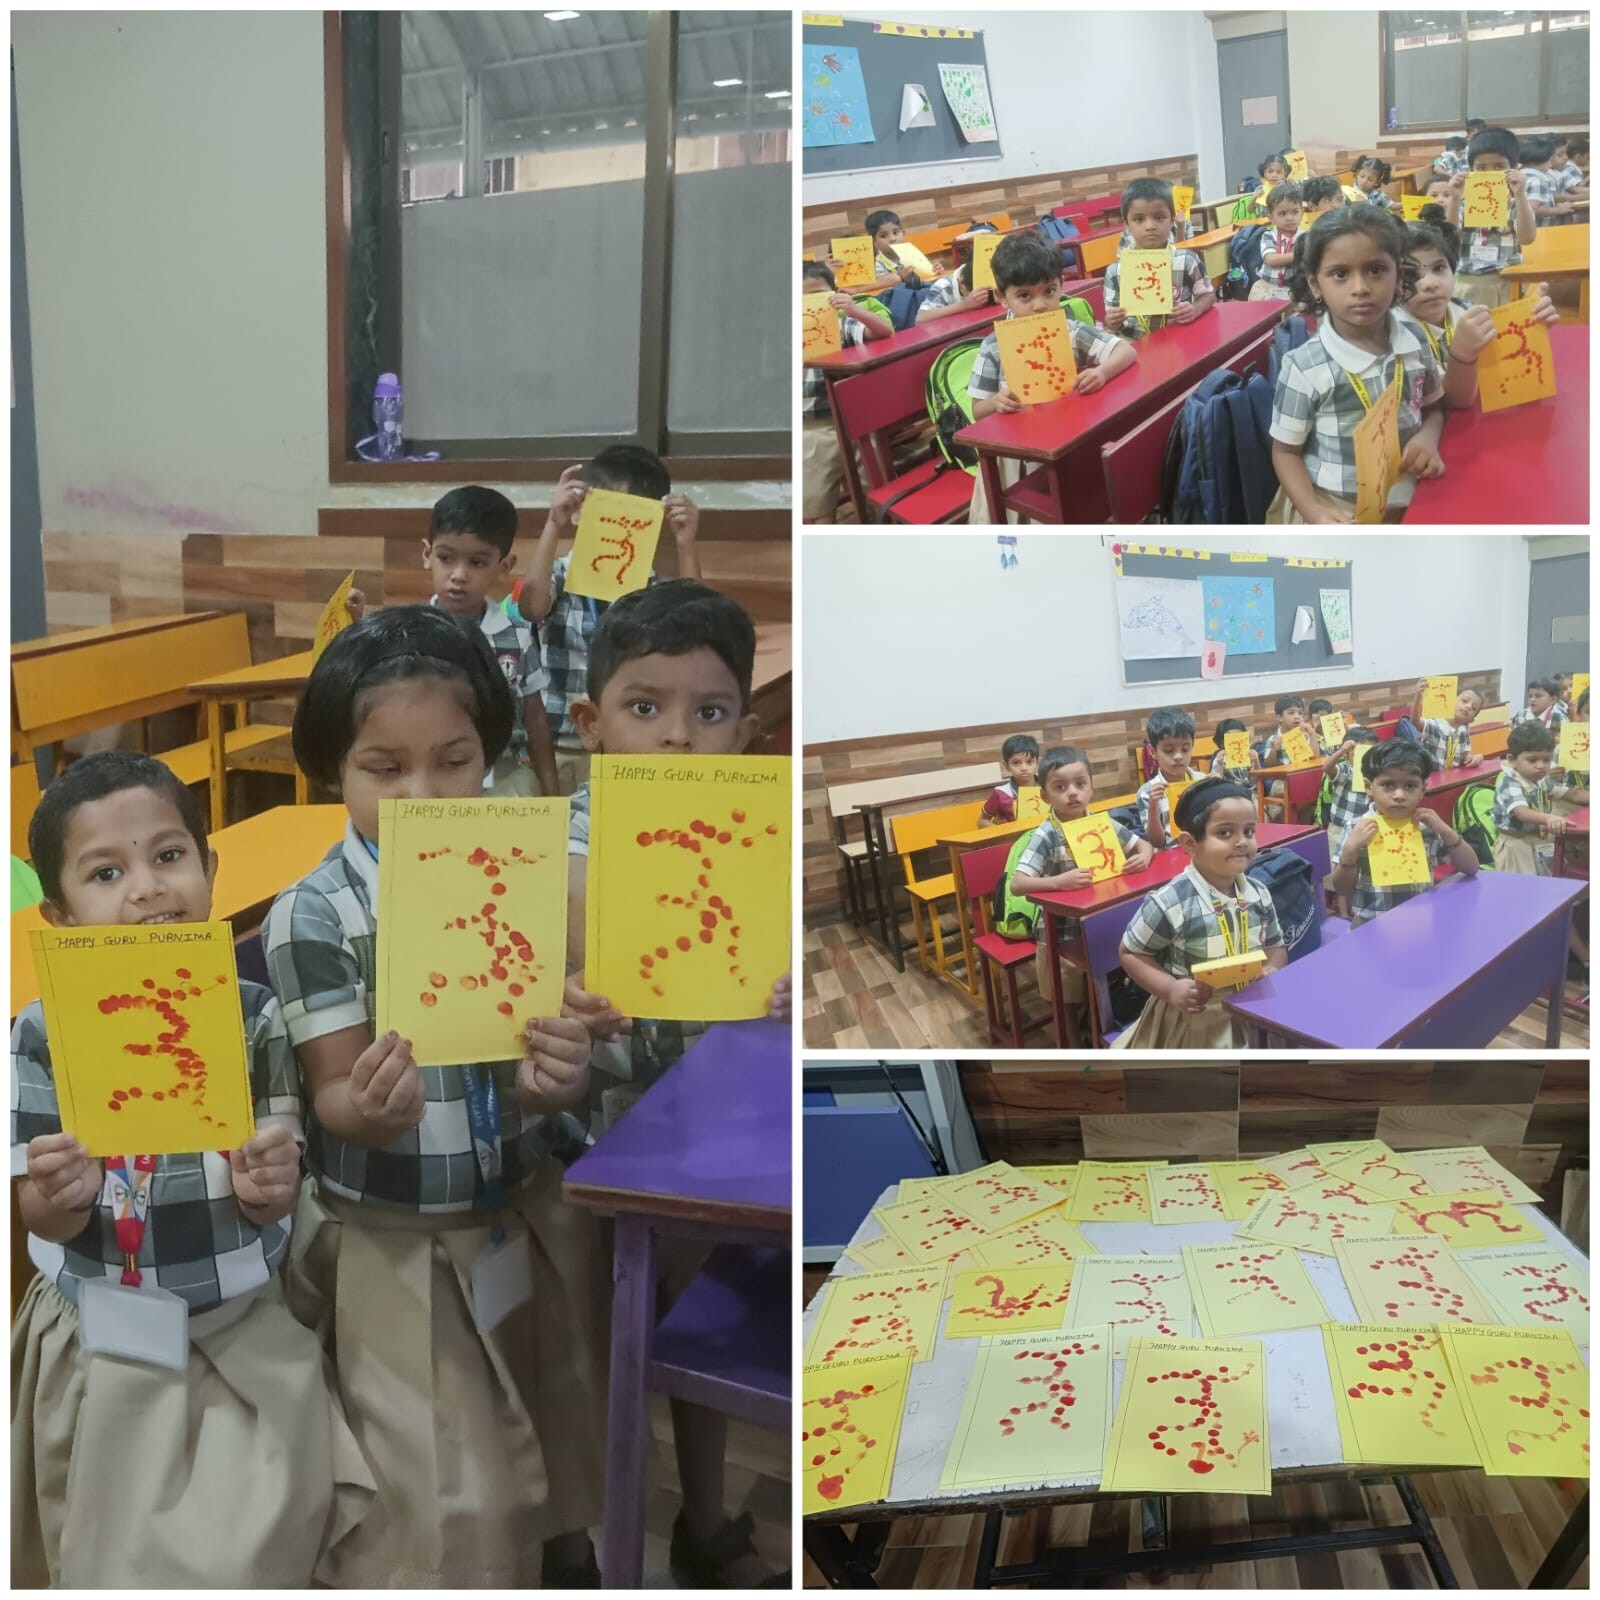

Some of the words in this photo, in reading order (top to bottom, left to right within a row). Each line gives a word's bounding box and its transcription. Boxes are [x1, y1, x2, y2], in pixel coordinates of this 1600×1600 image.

[611, 764, 656, 782] HAPPY
[664, 768, 704, 782] GURU
[714, 769, 779, 784] PURNIMA
[402, 803, 444, 819] HAPPY
[450, 804, 481, 818] GURU
[486, 803, 551, 818] PURNIMA
[55, 936, 96, 950] HAPPY
[103, 934, 137, 946] GURU
[149, 931, 213, 943] PURNIMA
[1000, 1338, 1027, 1346] HAPPY
[1055, 1333, 1094, 1341] PURNIMA
[1454, 1326, 1485, 1336] HAPPY
[1486, 1329, 1511, 1338] GURU
[1514, 1330, 1558, 1340] PURNIMA
[1150, 1342, 1177, 1351] HAPPY
[1204, 1345, 1244, 1353] PURNIMA
[822, 1360, 850, 1369] GURU
[853, 1353, 900, 1366] PURNIMA
